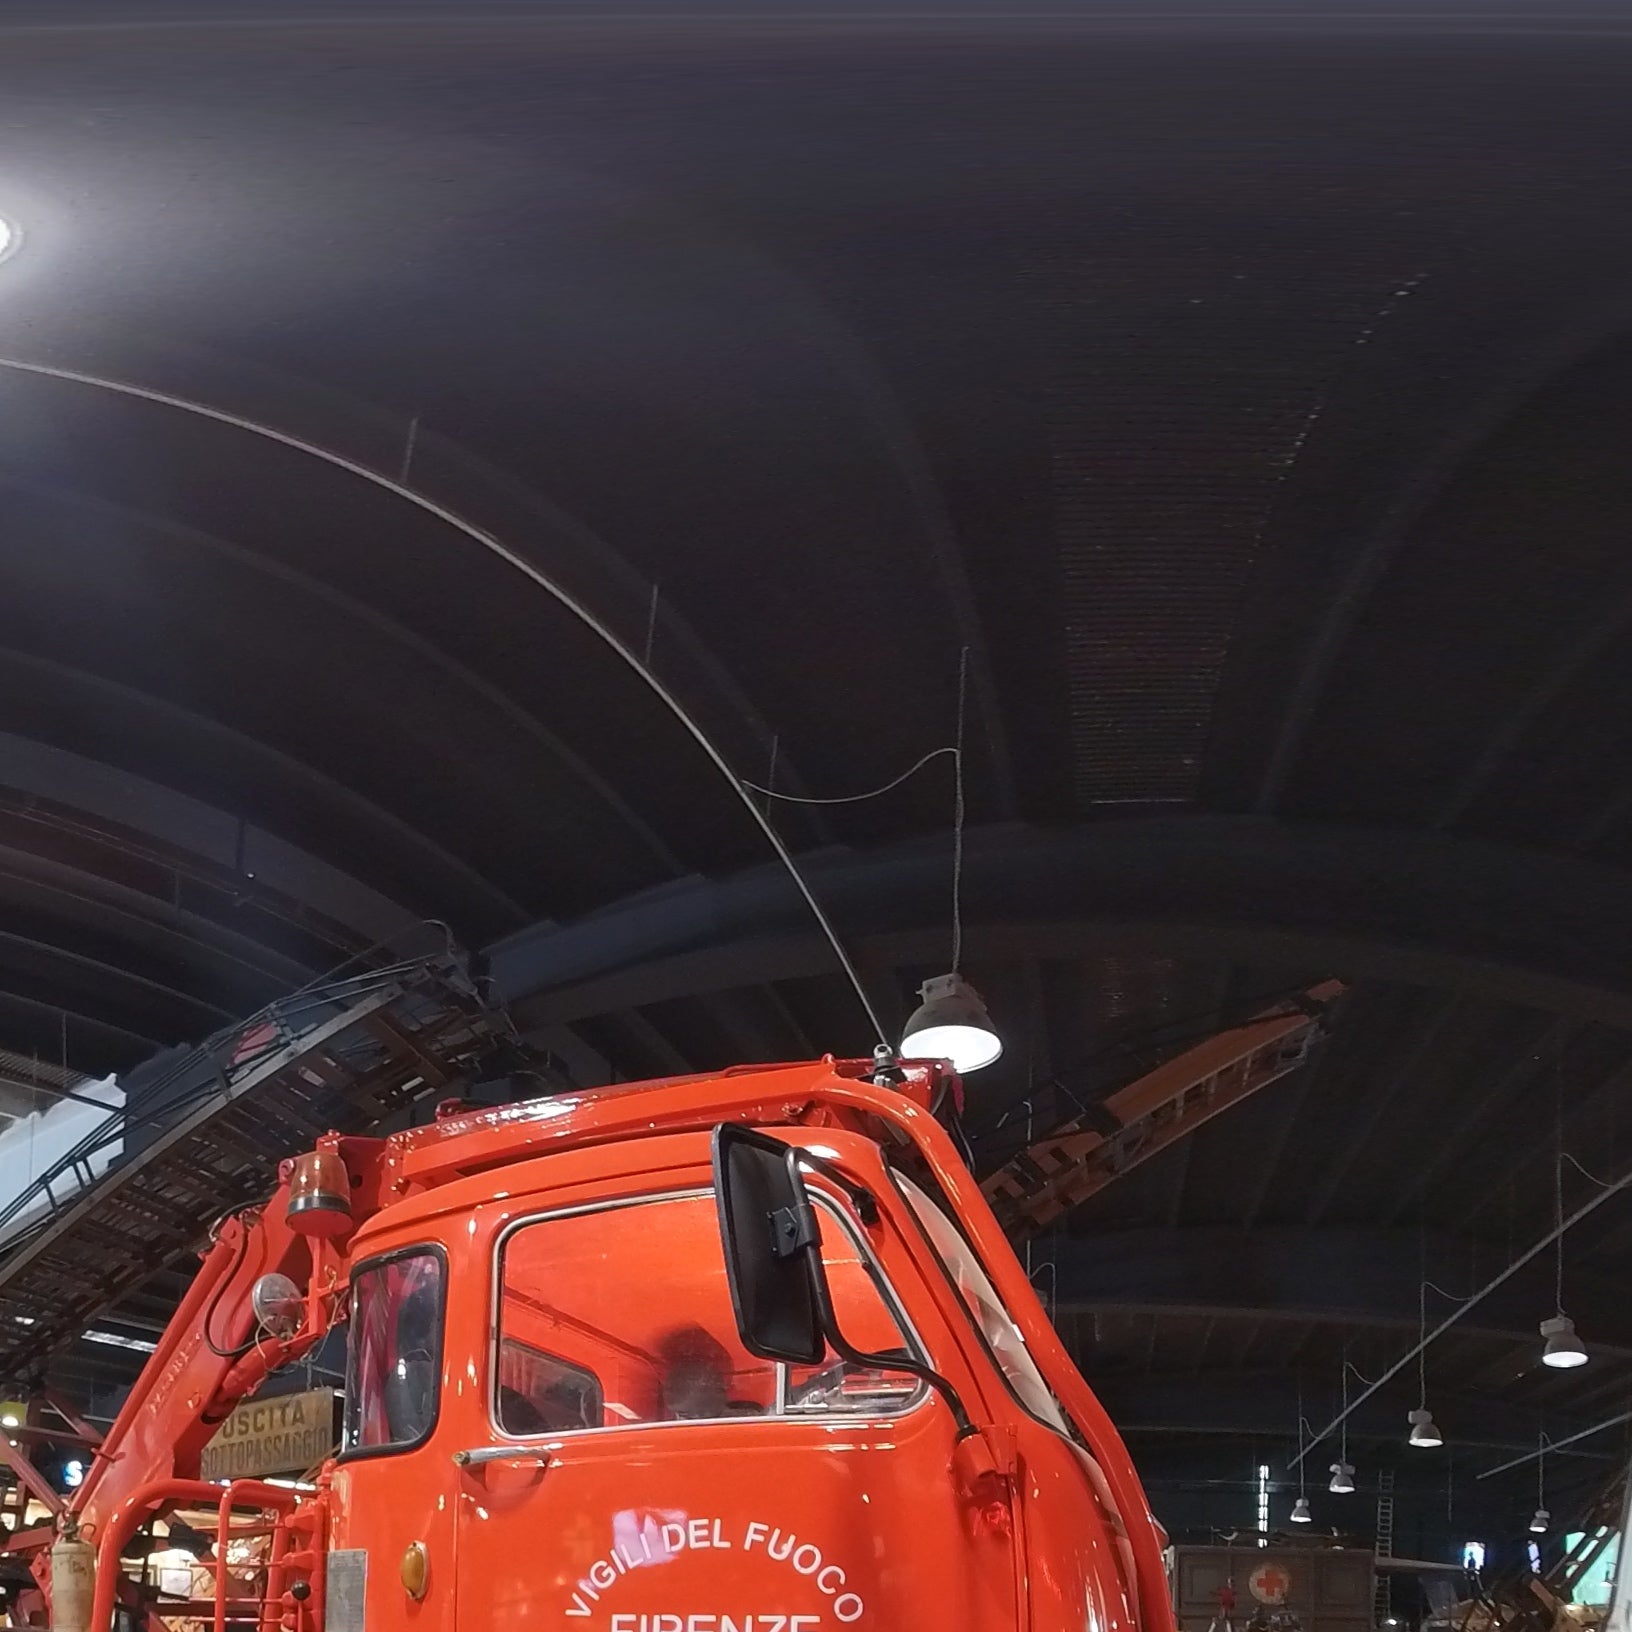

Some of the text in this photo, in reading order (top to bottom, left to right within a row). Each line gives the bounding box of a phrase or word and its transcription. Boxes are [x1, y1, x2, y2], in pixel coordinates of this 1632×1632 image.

[222, 1400, 305, 1438] USCITA
[565, 1518, 864, 1622] VIGILI DEL FUOCO
